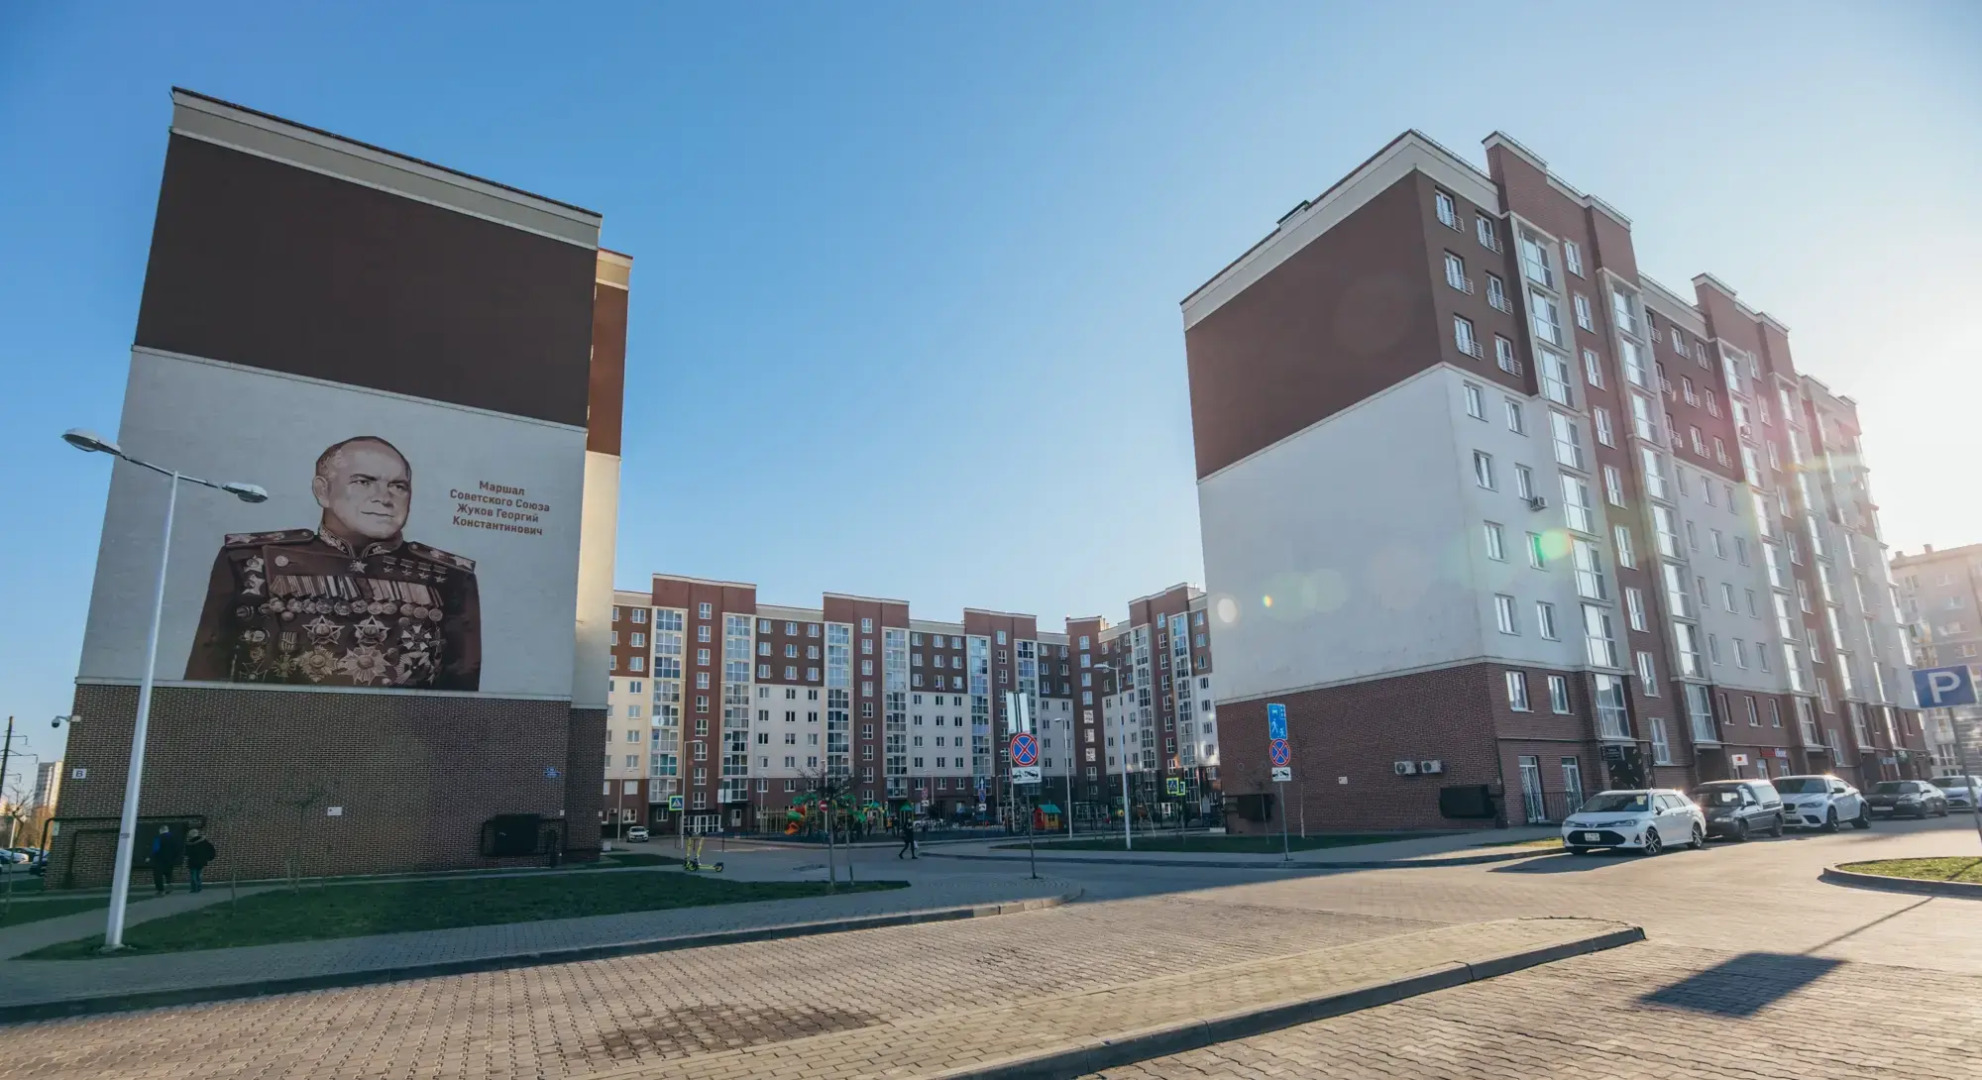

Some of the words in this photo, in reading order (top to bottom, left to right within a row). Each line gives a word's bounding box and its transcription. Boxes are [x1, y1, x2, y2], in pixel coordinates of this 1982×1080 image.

[479, 480, 525, 496] Маршал
[450, 489, 513, 507] Советского
[515, 499, 550, 512] Союза
[457, 503, 494, 516] Жуков
[496, 508, 540, 523] Георгий
[453, 515, 543, 536] Константинович
[1928, 671, 1961, 704] P
